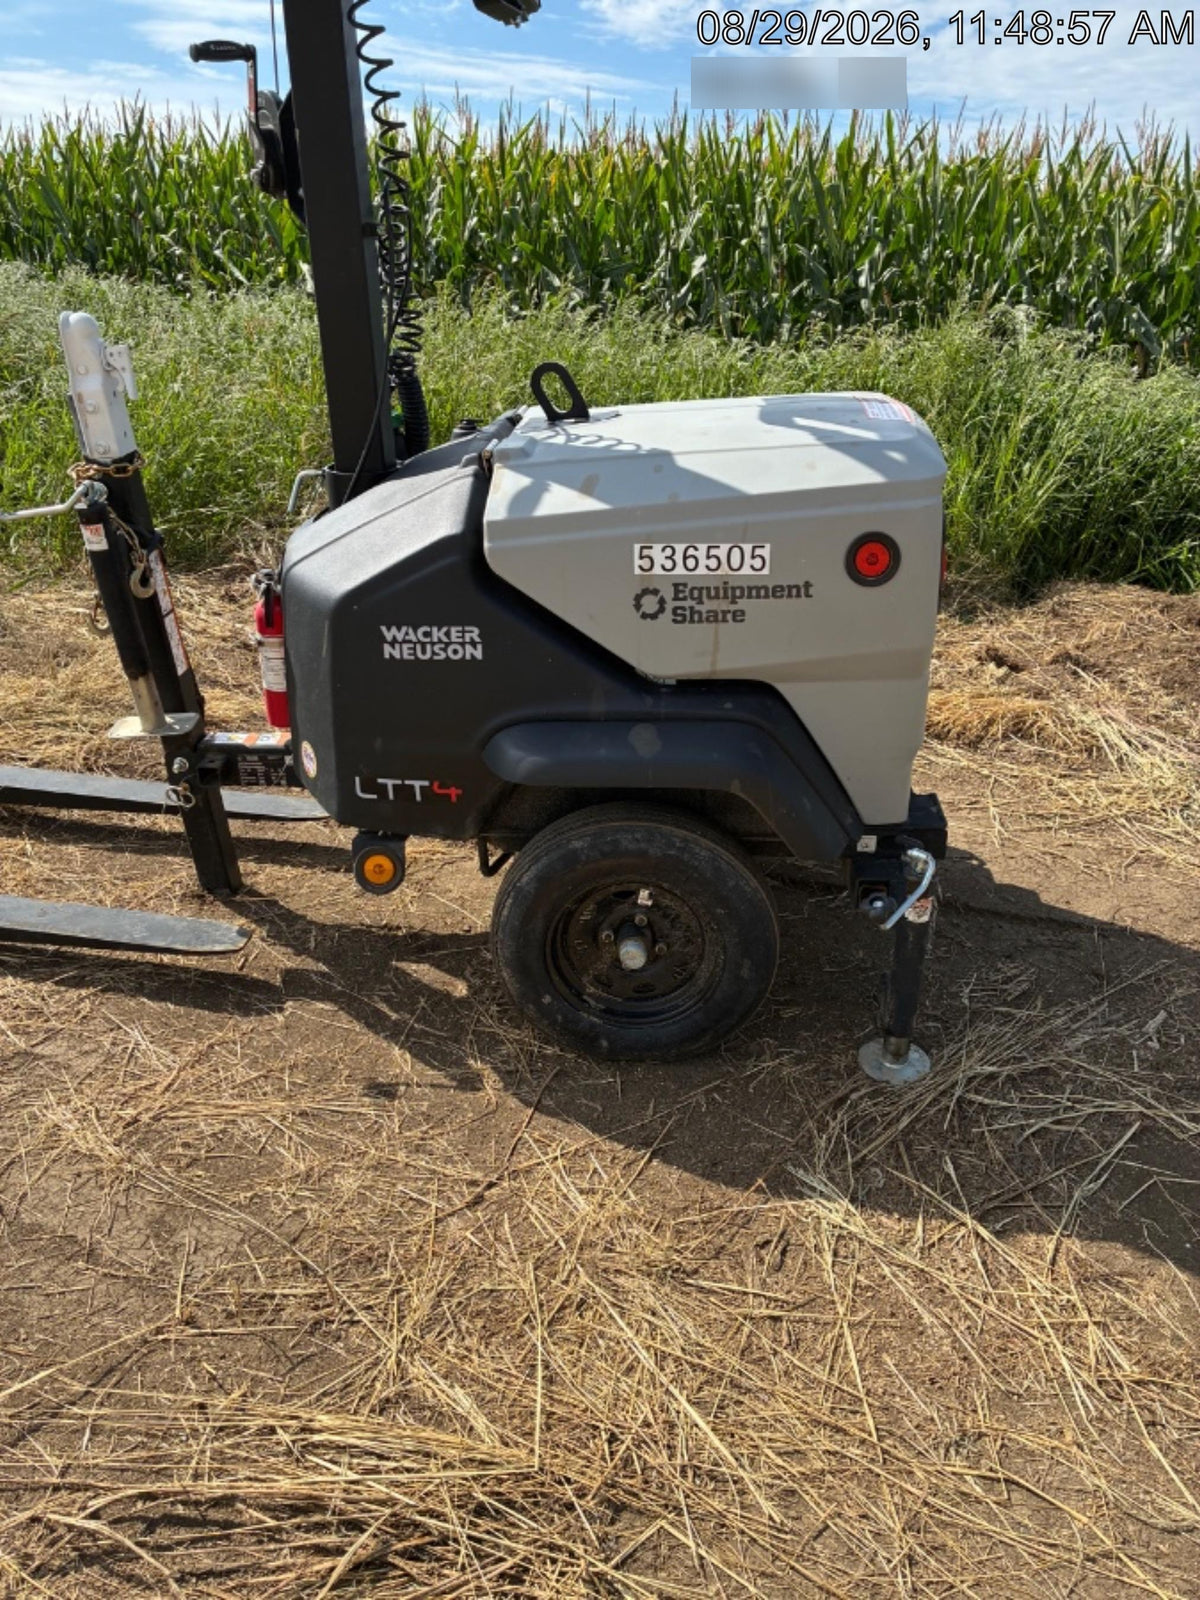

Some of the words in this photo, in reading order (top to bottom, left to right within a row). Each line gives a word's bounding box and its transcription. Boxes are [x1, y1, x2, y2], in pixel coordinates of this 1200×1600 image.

[638, 544, 767, 573] 536505
[671, 580, 815, 605] Equipment
[671, 605, 747, 624] Share
[379, 625, 482, 643] WACKER
[383, 643, 483, 660] NEUSON
[354, 776, 463, 803] LTT4
